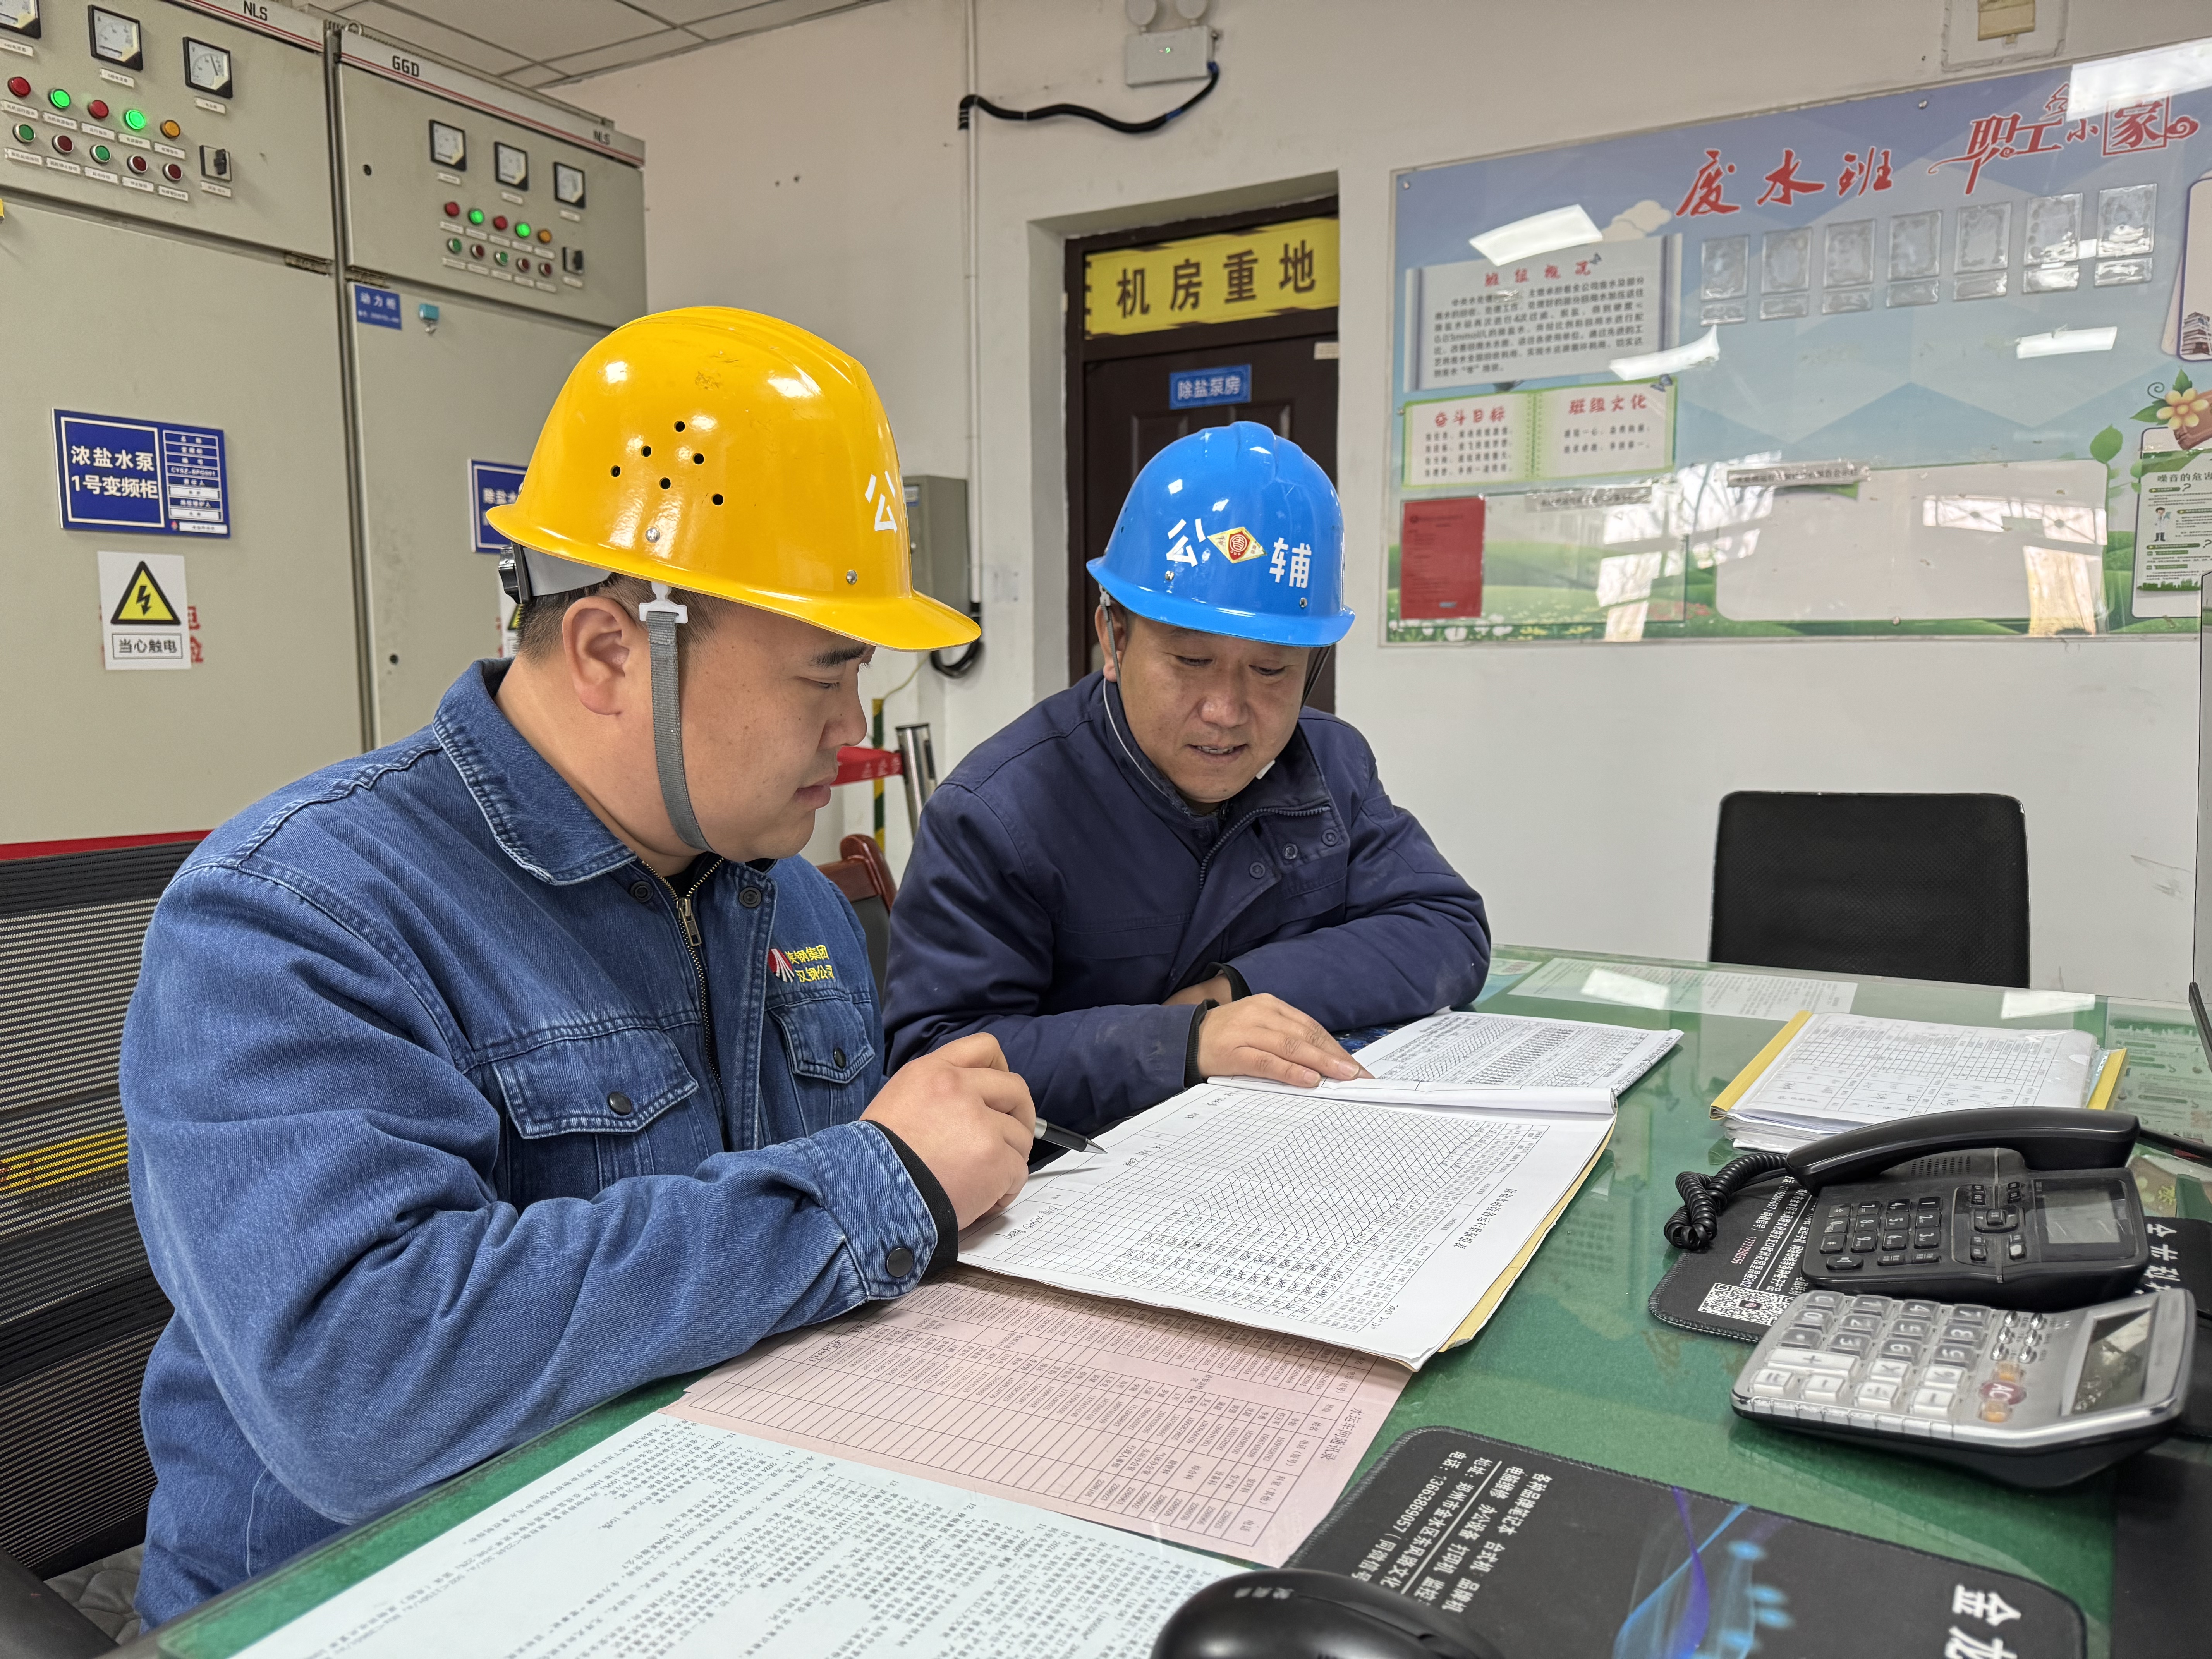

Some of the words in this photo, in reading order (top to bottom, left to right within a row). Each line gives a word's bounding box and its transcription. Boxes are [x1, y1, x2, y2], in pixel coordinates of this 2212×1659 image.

[244, 1, 268, 21] NLS
[392, 55, 419, 77] GGD
[594, 130, 610, 145] NLS
[1675, 147, 1893, 217] 废水班
[1117, 240, 1316, 318] 机房重地
[1178, 376, 1241, 400] 除盐泵房
[71, 445, 155, 472] 浓盐水泵
[71, 475, 158, 500] 1号变频柜
[865, 470, 898, 533] 公
[1166, 518, 1206, 567] 公
[1269, 537, 1312, 588] 辅
[118, 638, 177, 654] 当心触电
[1890, 1344, 1911, 1353] 6
[1988, 1382, 2013, 1400] AC
[1307, 1421, 1323, 1432] 姓名
[1317, 1407, 1367, 1462] 水运车间通讯录
[785, 1455, 817, 1474] 准化转变
[1108, 1444, 1137, 1468] 行政人事部
[1123, 1448, 1152, 1472] 水运办公室
[1139, 1451, 1167, 1475] 气体办公室
[1283, 1438, 1311, 1467] 电话（短号）
[817, 1461, 837, 1472] 管控
[1182, 1464, 1202, 1480] 综合科
[1205, 1470, 1225, 1486] 设备科
[1221, 1474, 1241, 1490] 生产科
[1238, 1477, 1257, 1494] 安环科
[1256, 1474, 1286, 1506] 科室（其他）
[1490, 1466, 1525, 1500] 电脑维修
[1498, 1472, 1553, 1535] 各种品牌笔记本
[1238, 1518, 1257, 1533] 电话
[1458, 1504, 1497, 1541] 办公设备
[1433, 1543, 1470, 1575] 打印机
[1470, 1541, 1506, 1573] 台式机
[1413, 1576, 1445, 1606] 监控
[1441, 1578, 1480, 1613] 品牌机
[1944, 1584, 2021, 1659] 金龙
